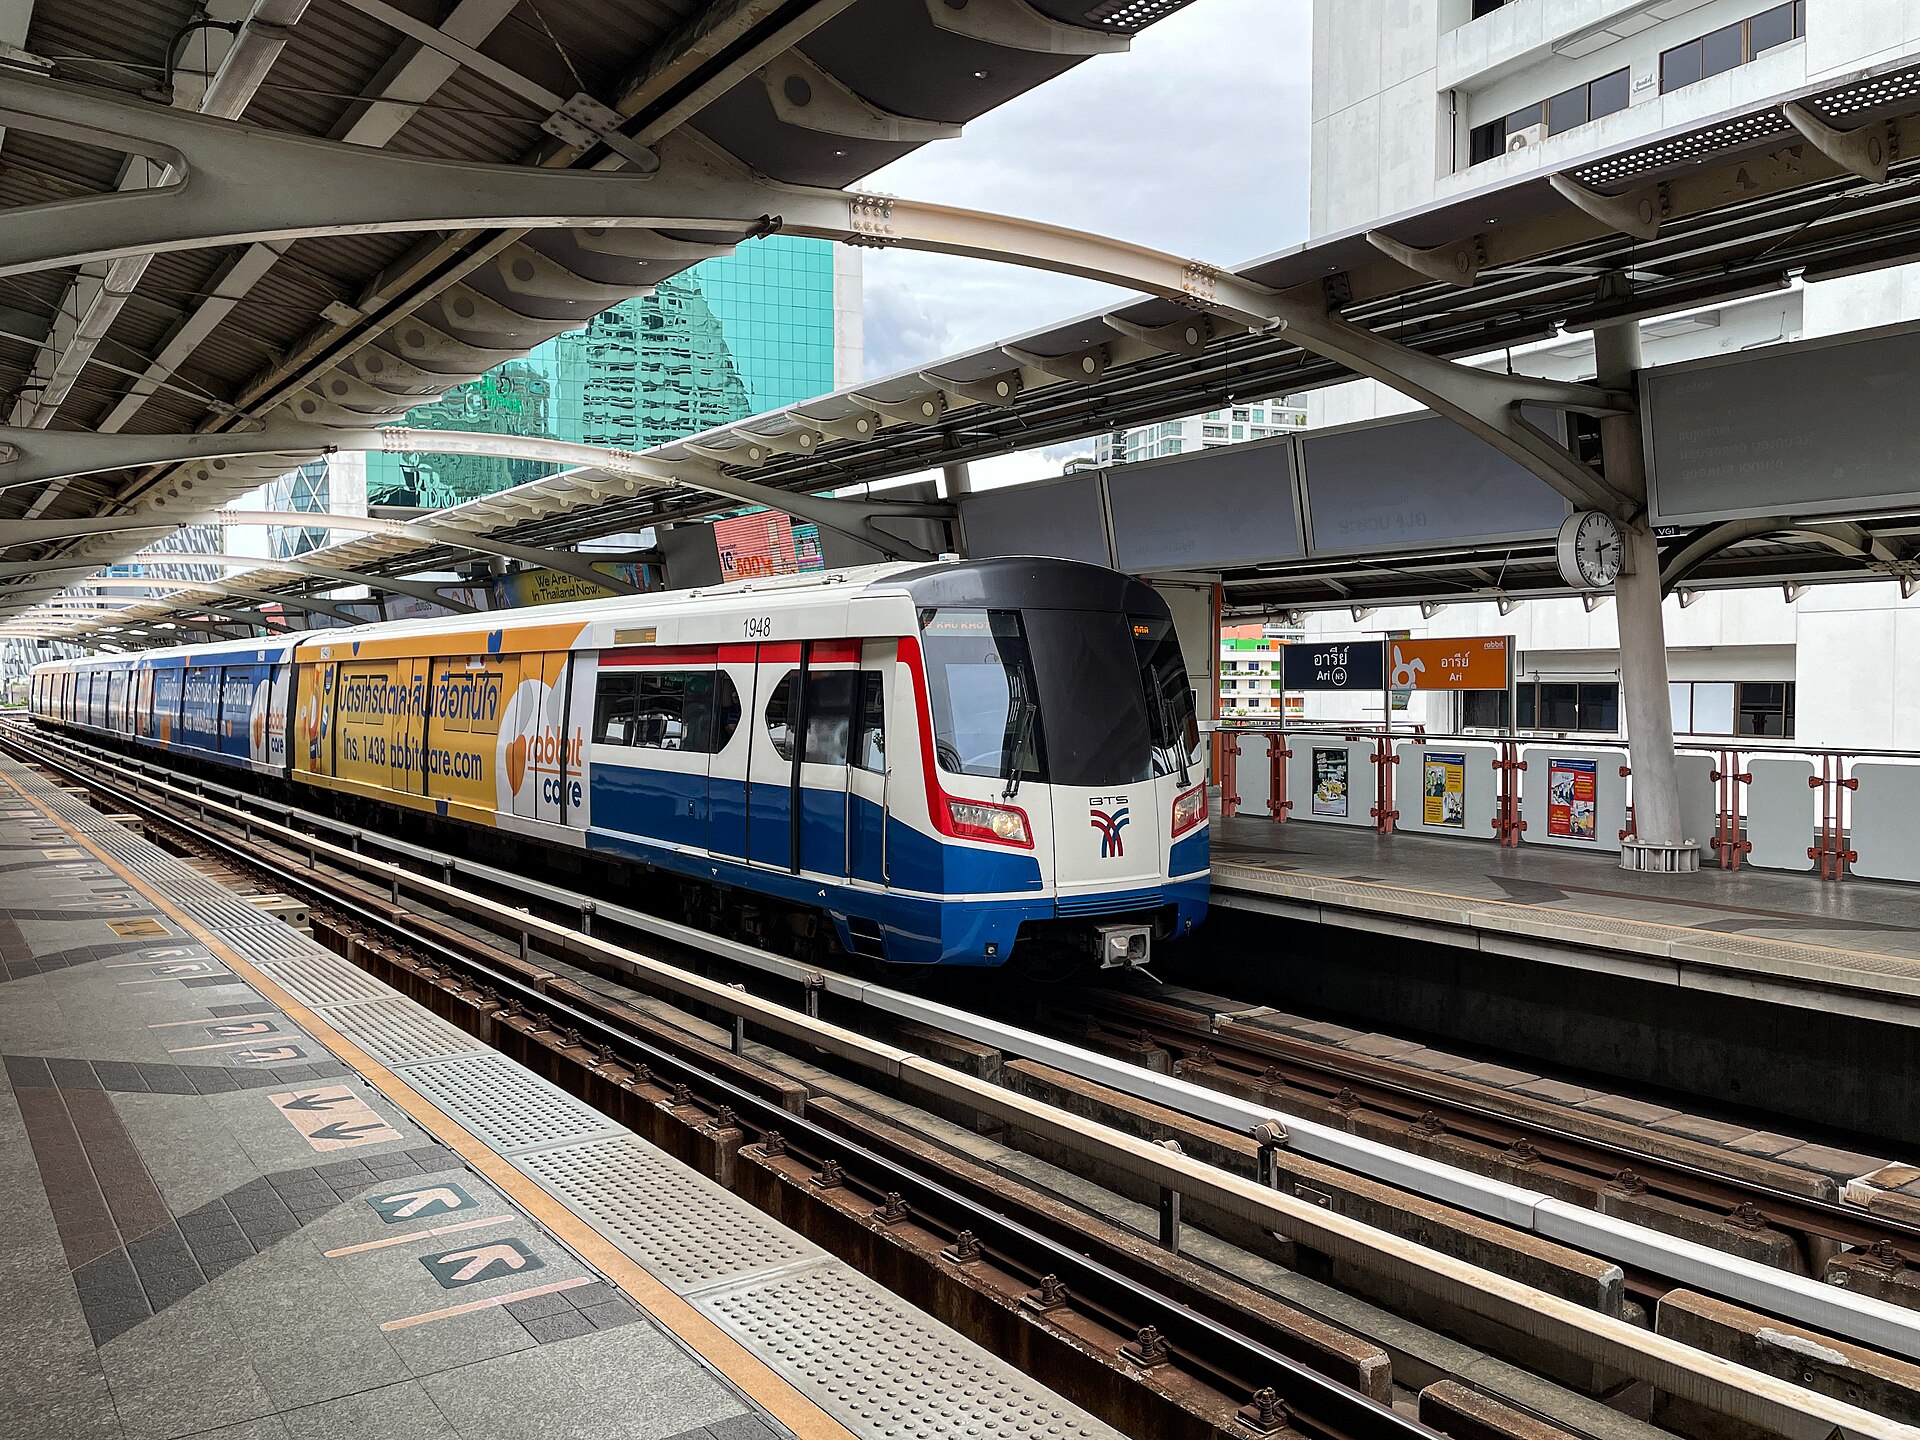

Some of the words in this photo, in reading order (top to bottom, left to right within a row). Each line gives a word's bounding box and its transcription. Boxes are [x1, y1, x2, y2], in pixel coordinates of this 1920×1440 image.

[535, 575, 550, 588] We
[551, 573, 567, 586] Are
[532, 590, 540, 602] In
[540, 584, 575, 601] Thailand
[743, 616, 771, 638] 1948
[1484, 641, 1504, 649] rabbit
[1313, 645, 1350, 666] อารีย์
[1441, 651, 1471, 668] อารีย์
[1316, 670, 1330, 681] Ari
[1449, 672, 1463, 682] Ari
[363, 735, 386, 766] 1438
[528, 725, 583, 768] rabbit
[543, 777, 582, 808] care
[1089, 795, 1129, 806] BTS
